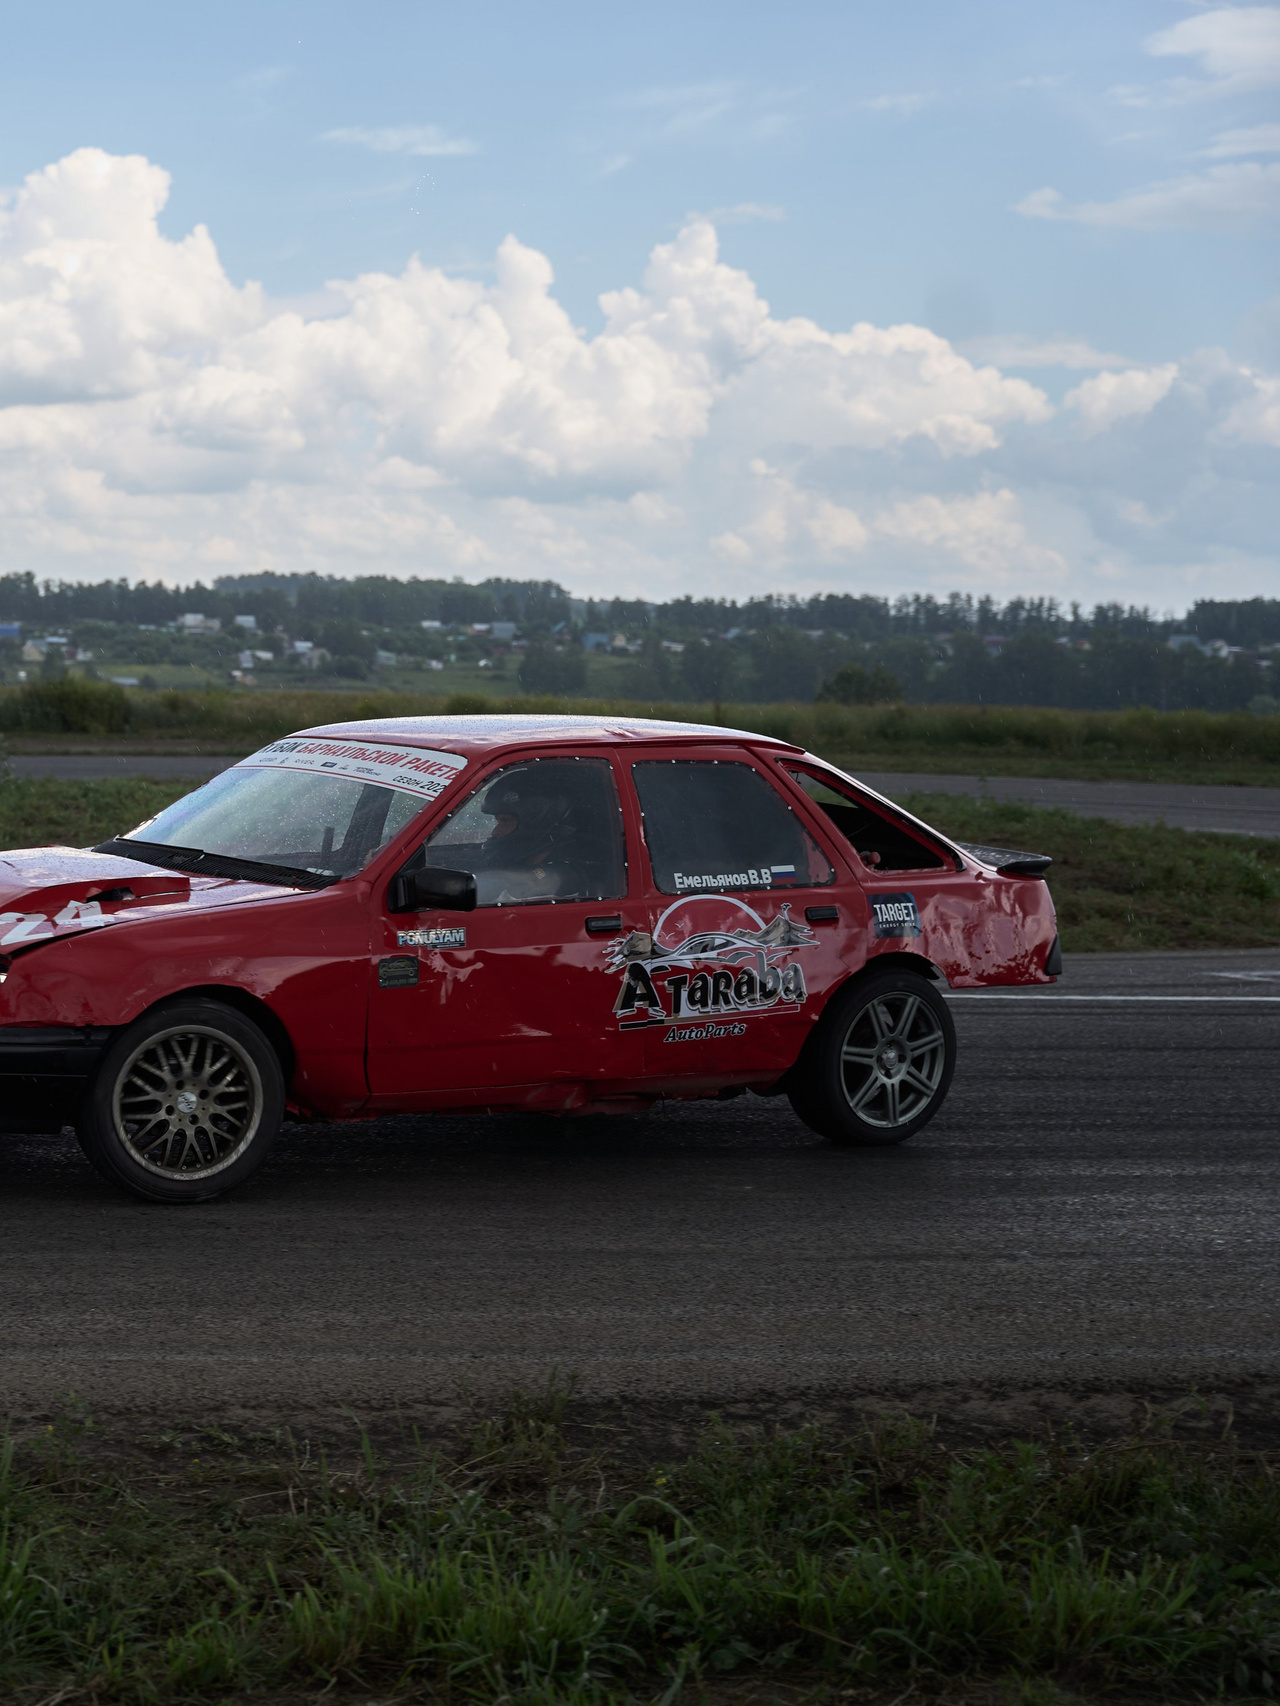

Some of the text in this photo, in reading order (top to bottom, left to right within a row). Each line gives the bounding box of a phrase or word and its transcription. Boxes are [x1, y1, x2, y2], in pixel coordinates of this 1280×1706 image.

[295, 742, 412, 767] БАРНАУЛЬСКОЙ
[392, 775, 447, 794] СЕЗОН 202
[673, 872, 750, 889] Емельянов
[873, 903, 915, 922] TARGET
[397, 928, 465, 946] PONULYAM
[663, 1022, 746, 1042] AutoParts
